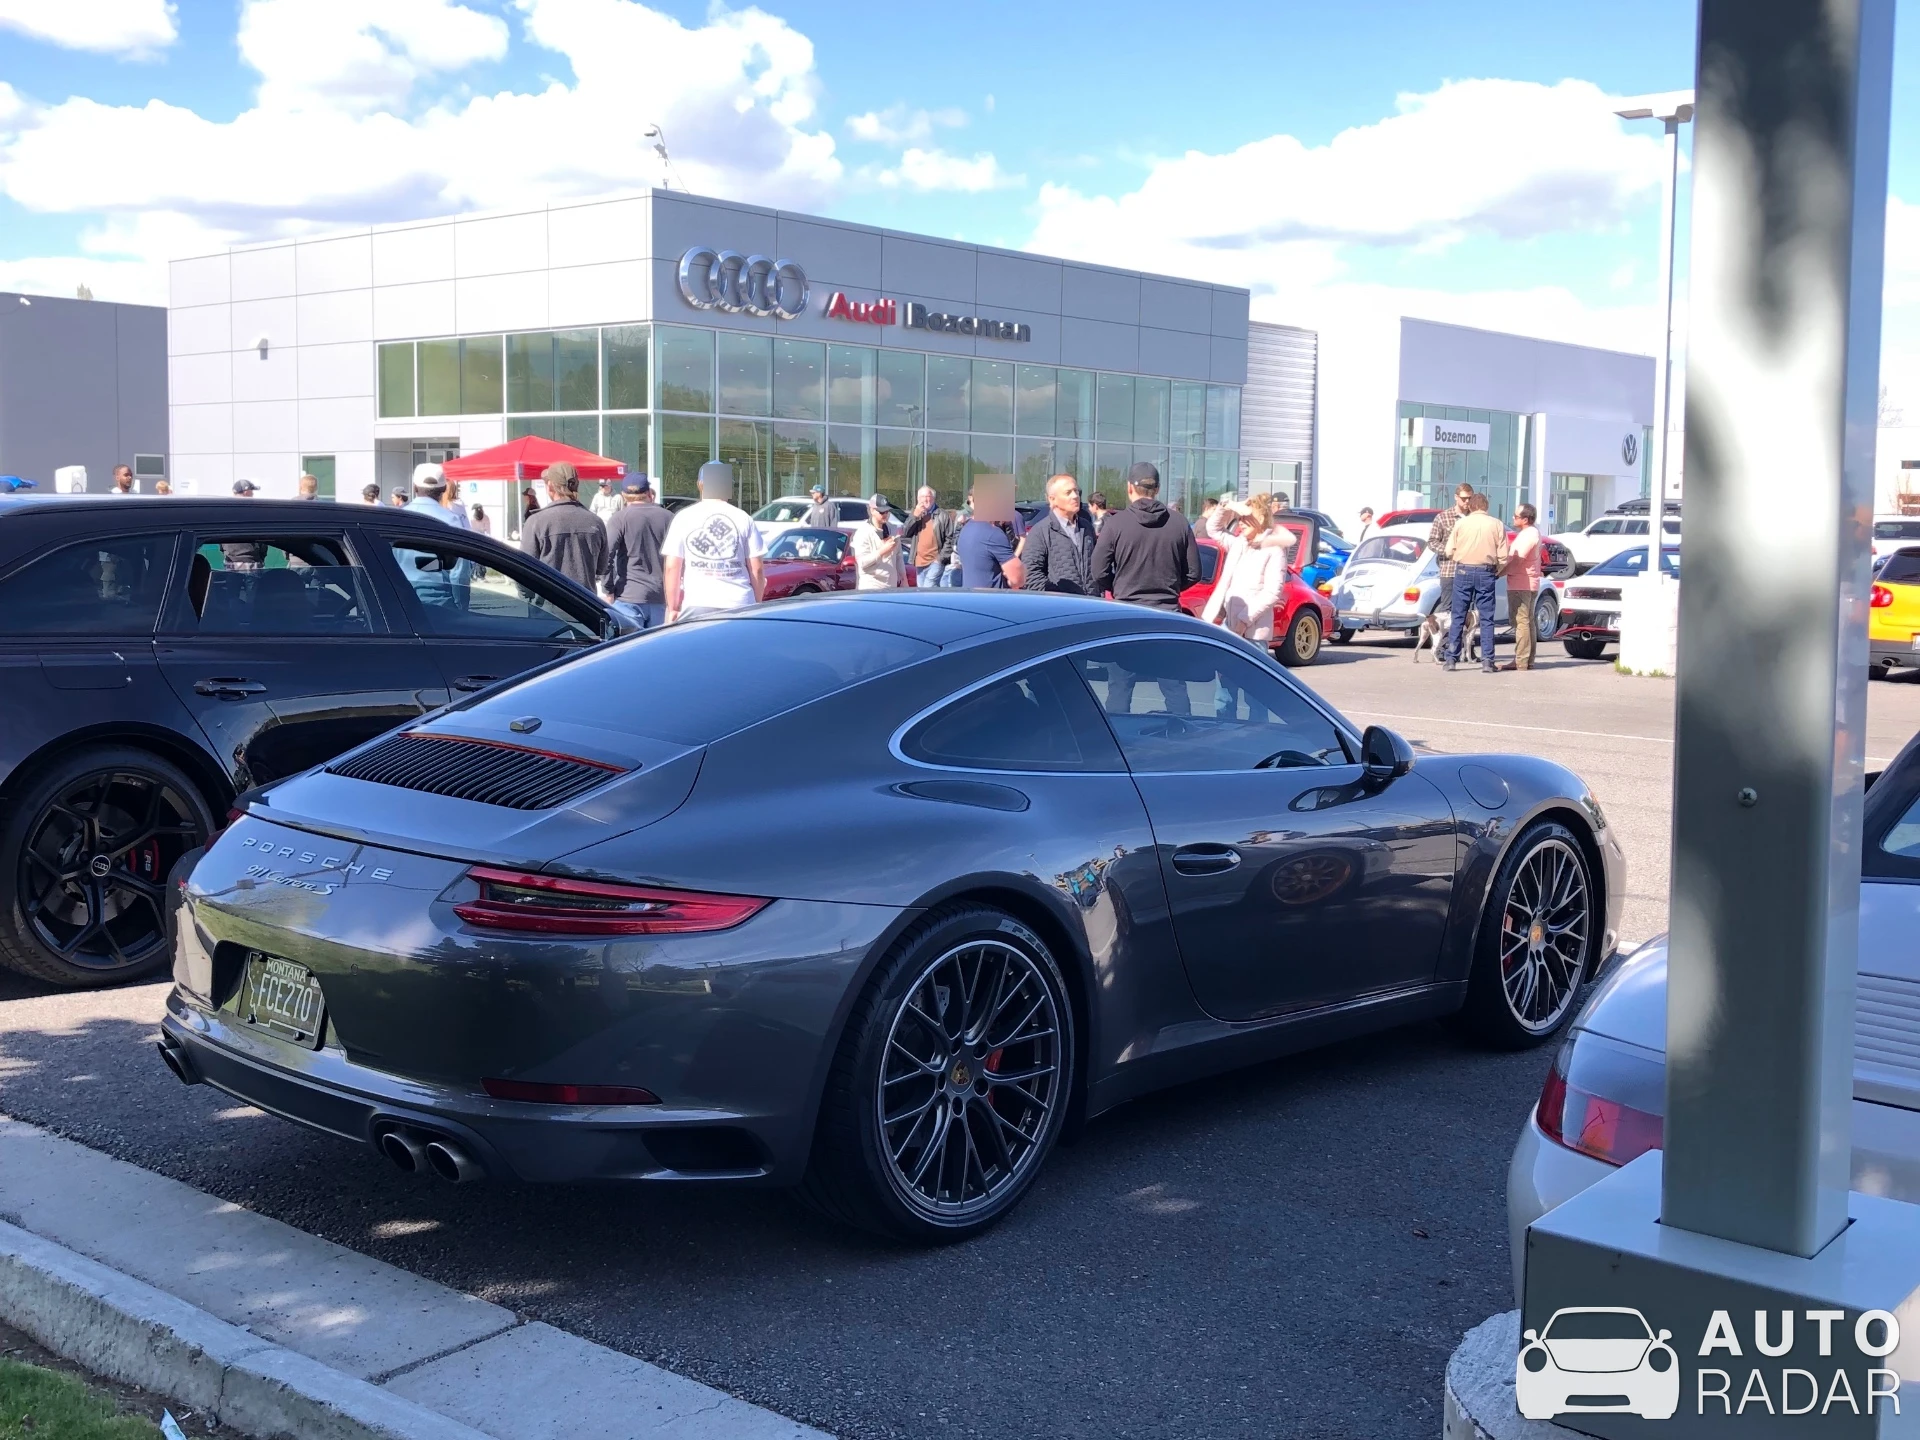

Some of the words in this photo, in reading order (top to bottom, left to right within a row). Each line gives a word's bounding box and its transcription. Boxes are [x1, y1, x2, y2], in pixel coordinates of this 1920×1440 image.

[824, 291, 897, 326] Audi
[904, 301, 1031, 343] Bozeman
[1434, 425, 1477, 444] Bozeman
[241, 837, 395, 882] PORSCHE
[312, 883, 340, 896] S
[265, 959, 307, 983] MONTANA
[257, 972, 313, 1022] FCE270
